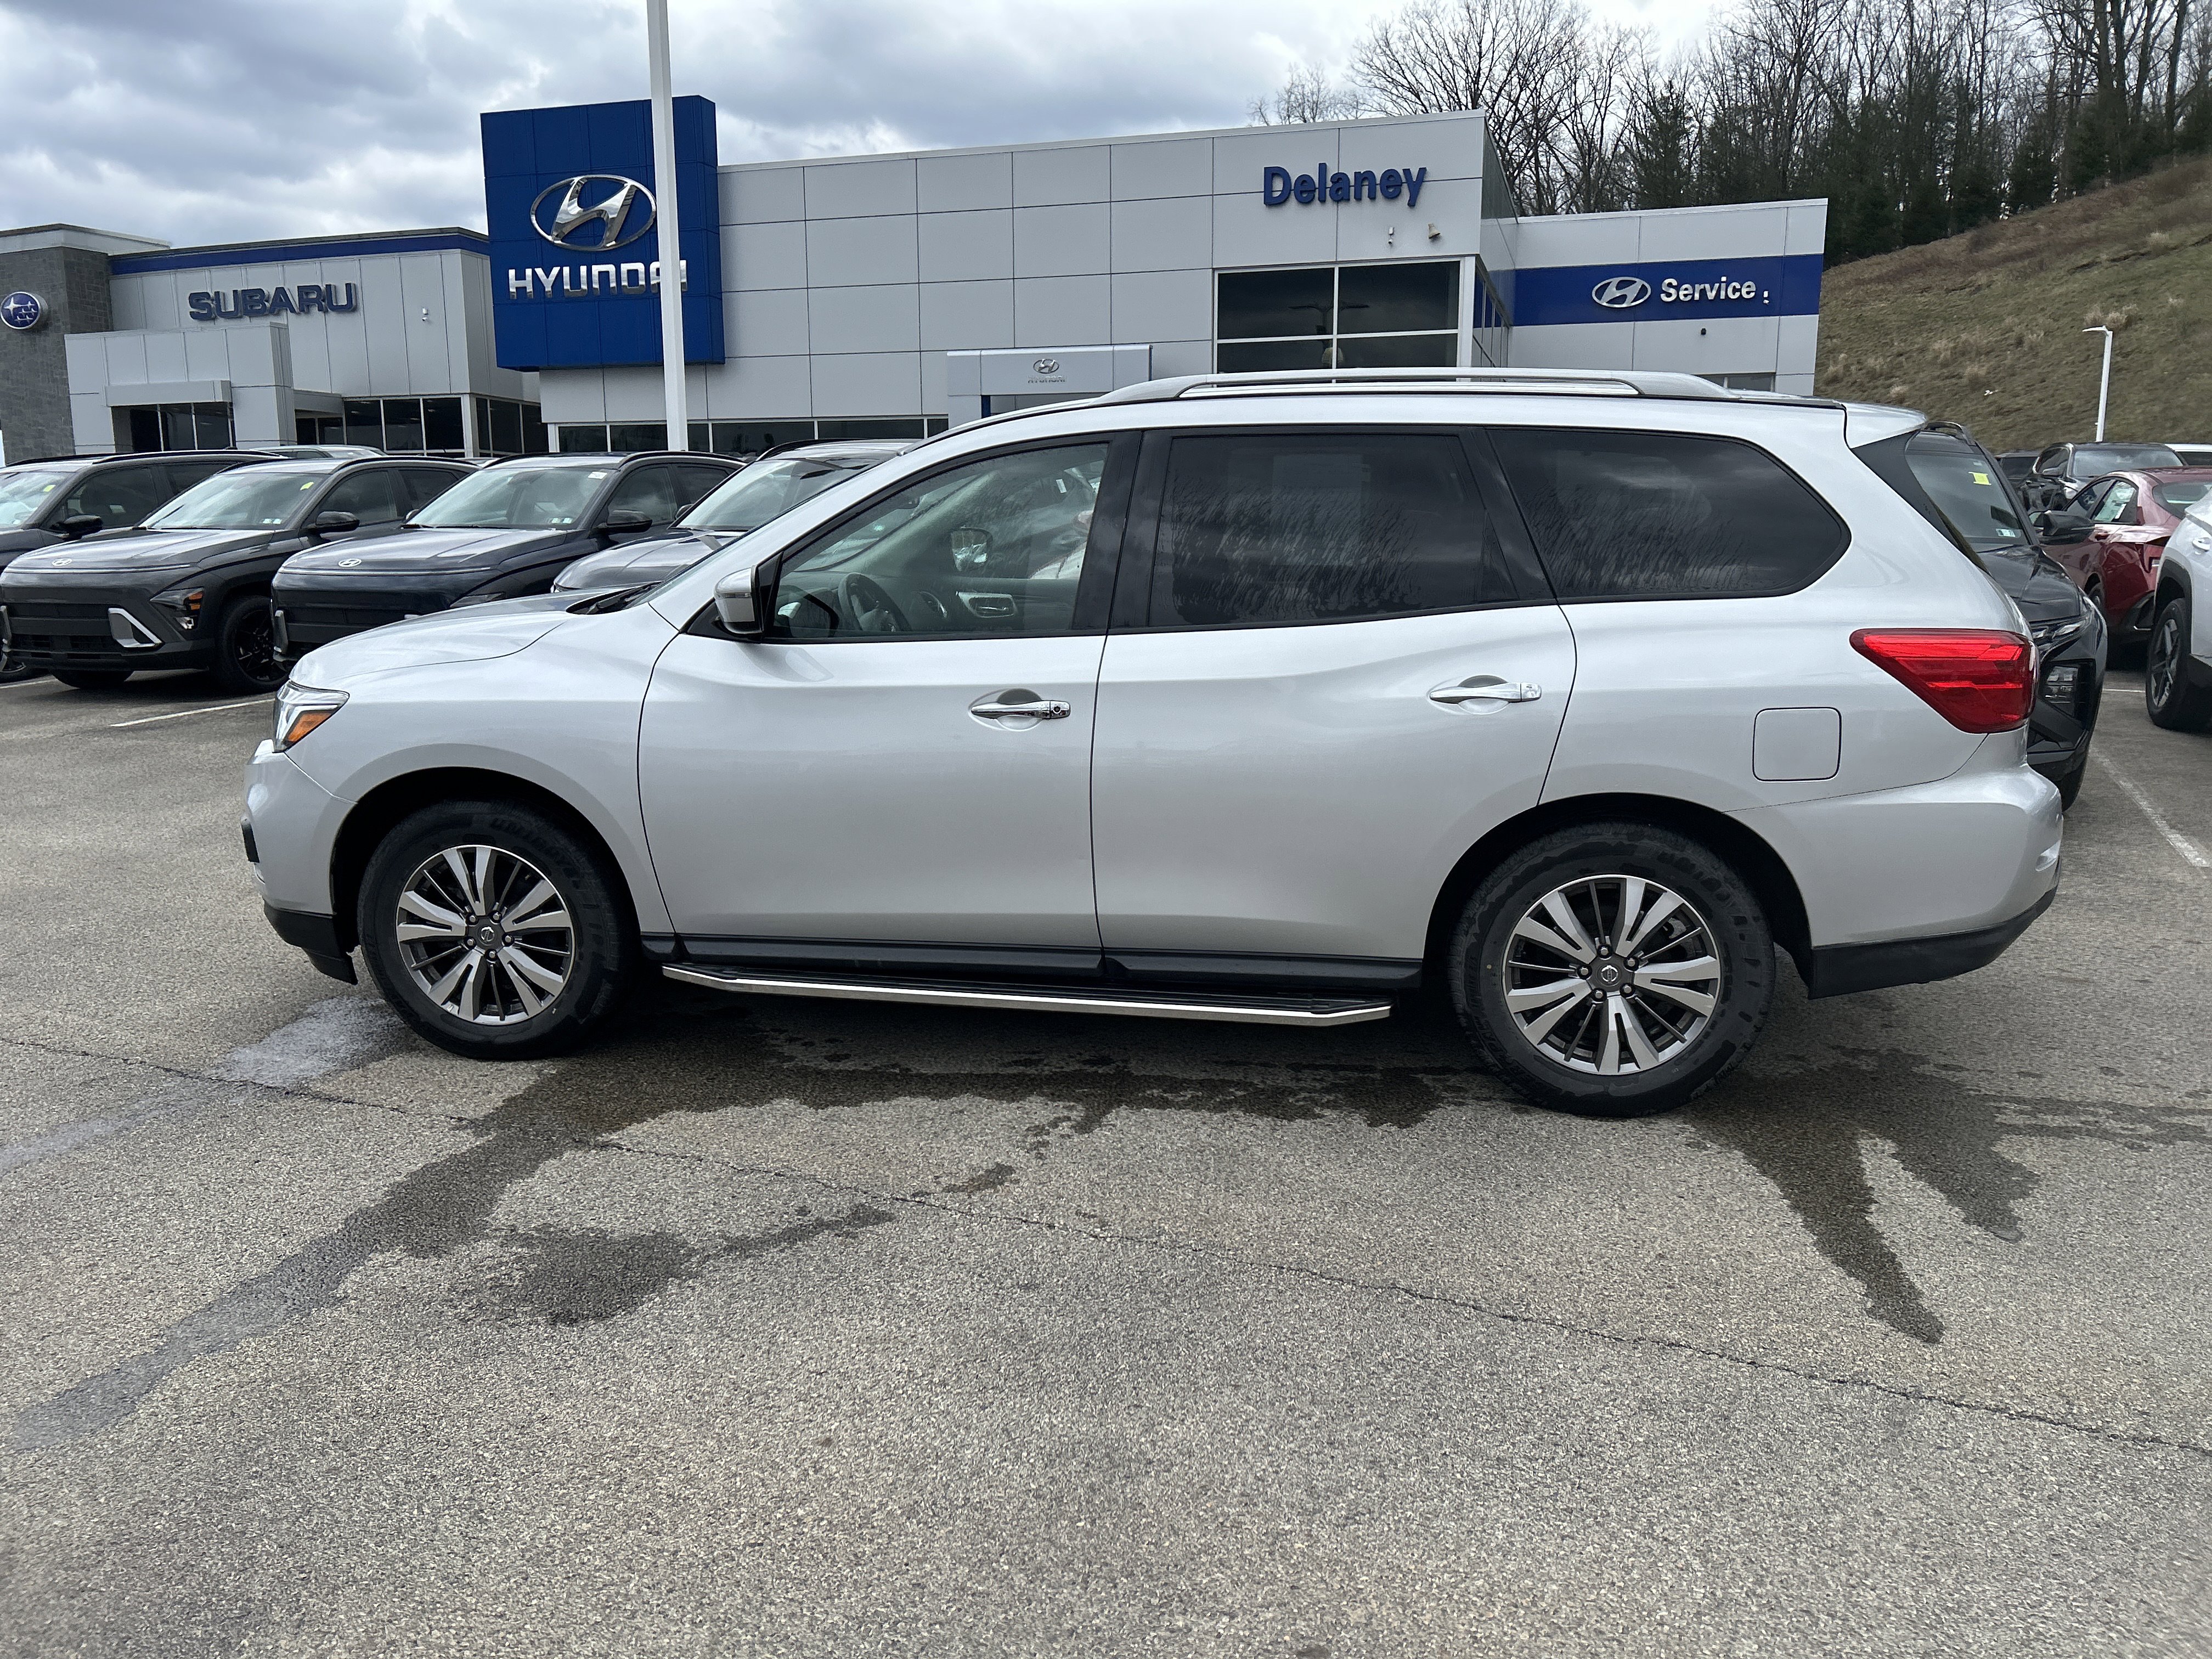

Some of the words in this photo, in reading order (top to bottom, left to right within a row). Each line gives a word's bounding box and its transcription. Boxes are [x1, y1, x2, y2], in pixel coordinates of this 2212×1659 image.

[1263, 162, 1427, 207] Delaney
[188, 283, 357, 320] SUBARU
[1660, 276, 1756, 302] Service
